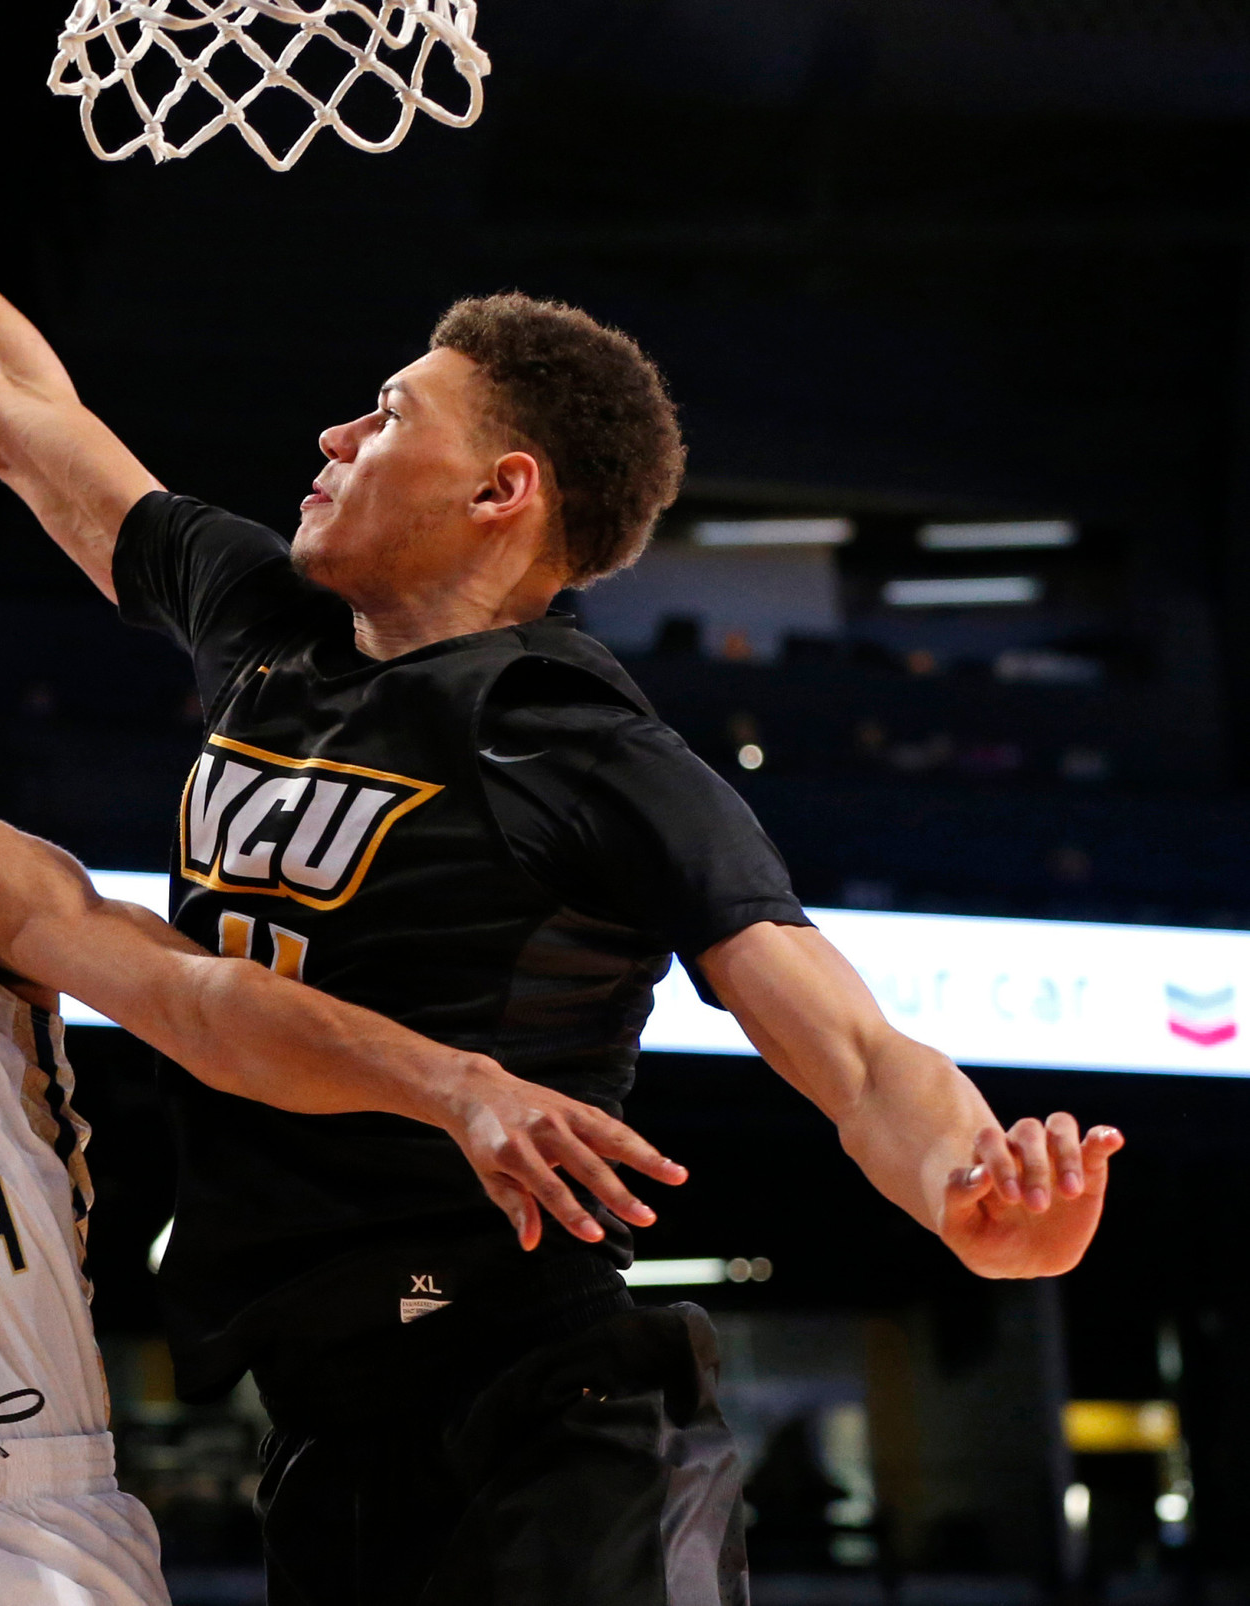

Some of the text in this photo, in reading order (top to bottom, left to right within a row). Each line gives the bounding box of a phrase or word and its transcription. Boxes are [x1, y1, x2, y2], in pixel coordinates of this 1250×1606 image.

[190, 751, 397, 891] VCU
[989, 972, 1089, 1024] car
[410, 1274, 443, 1295] XL
